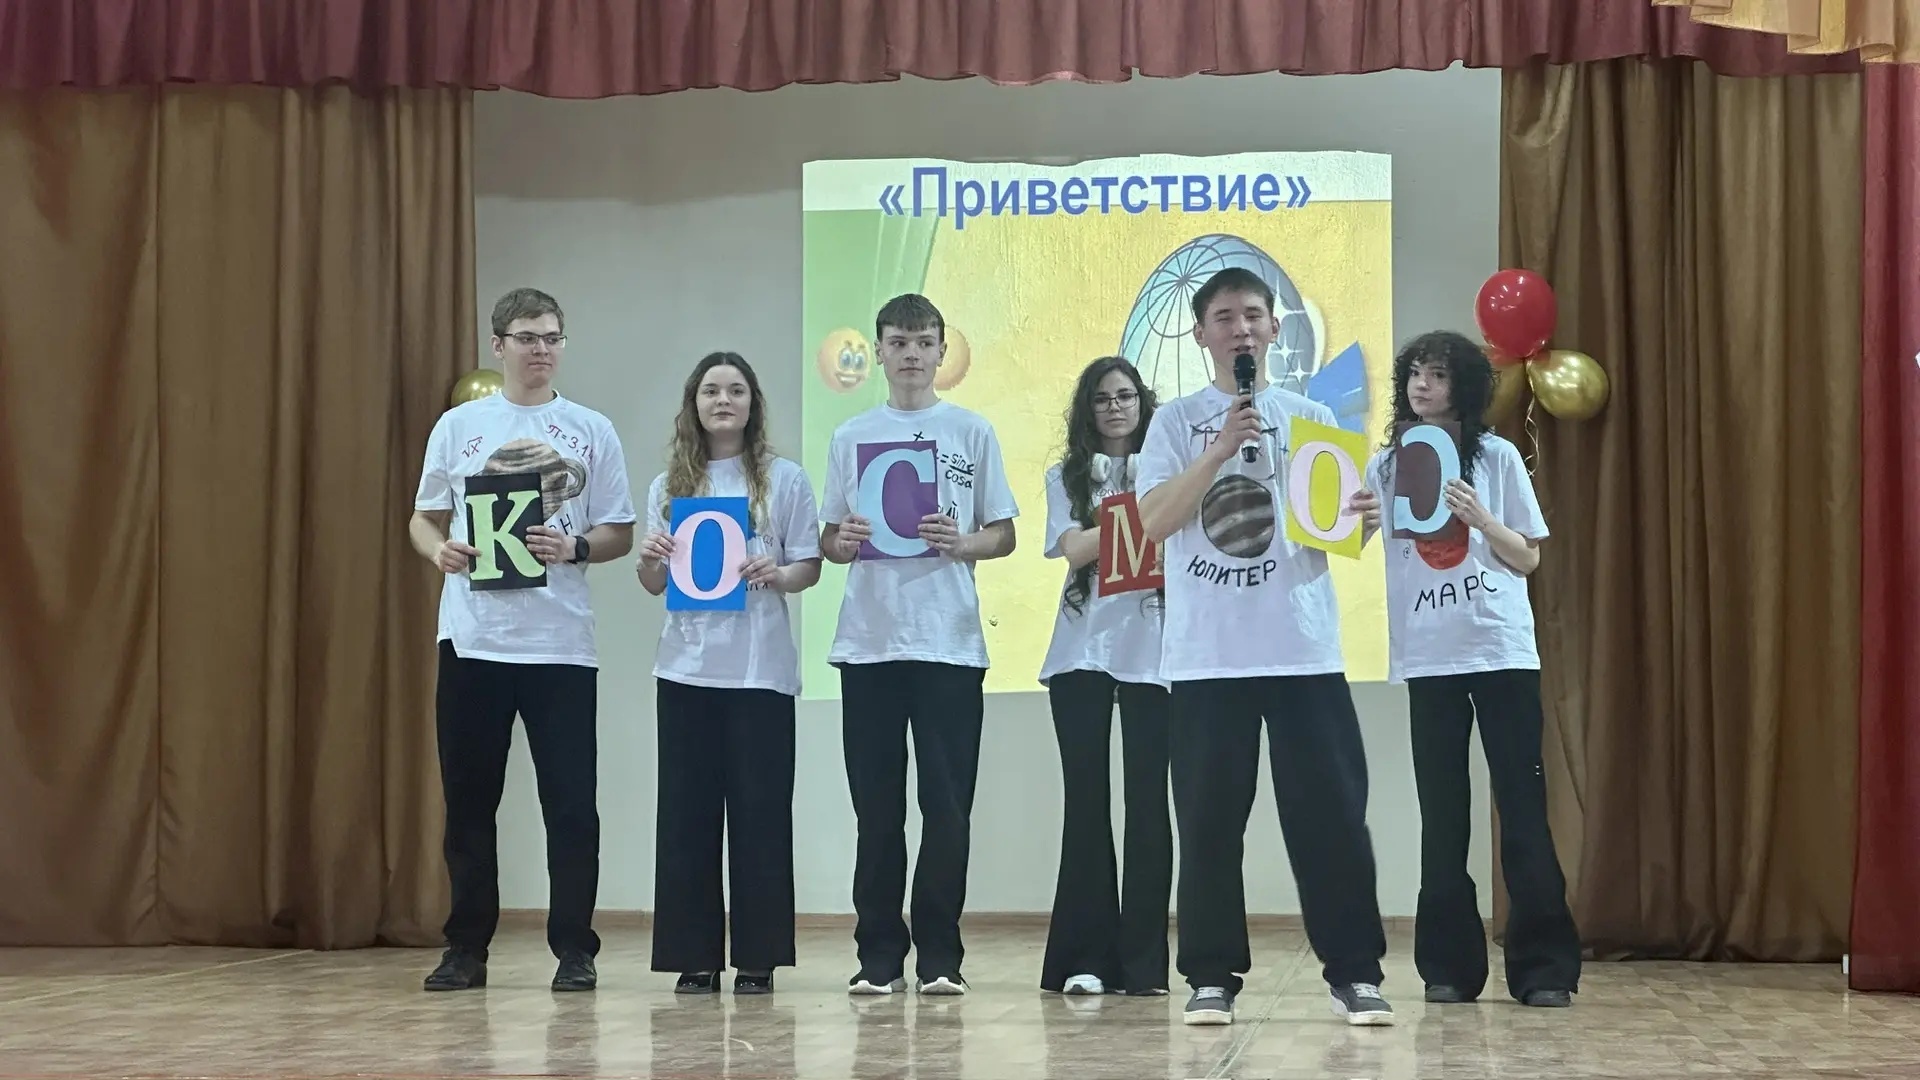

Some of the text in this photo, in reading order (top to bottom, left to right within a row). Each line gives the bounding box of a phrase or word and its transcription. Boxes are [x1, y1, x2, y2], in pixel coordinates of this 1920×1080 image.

[878, 166, 1312, 230] «Приветствие»
[465, 489, 546, 581] К
[857, 448, 936, 558] С
[1187, 555, 1277, 588] ЮПИТЕР
[1414, 571, 1498, 612] МАРС
